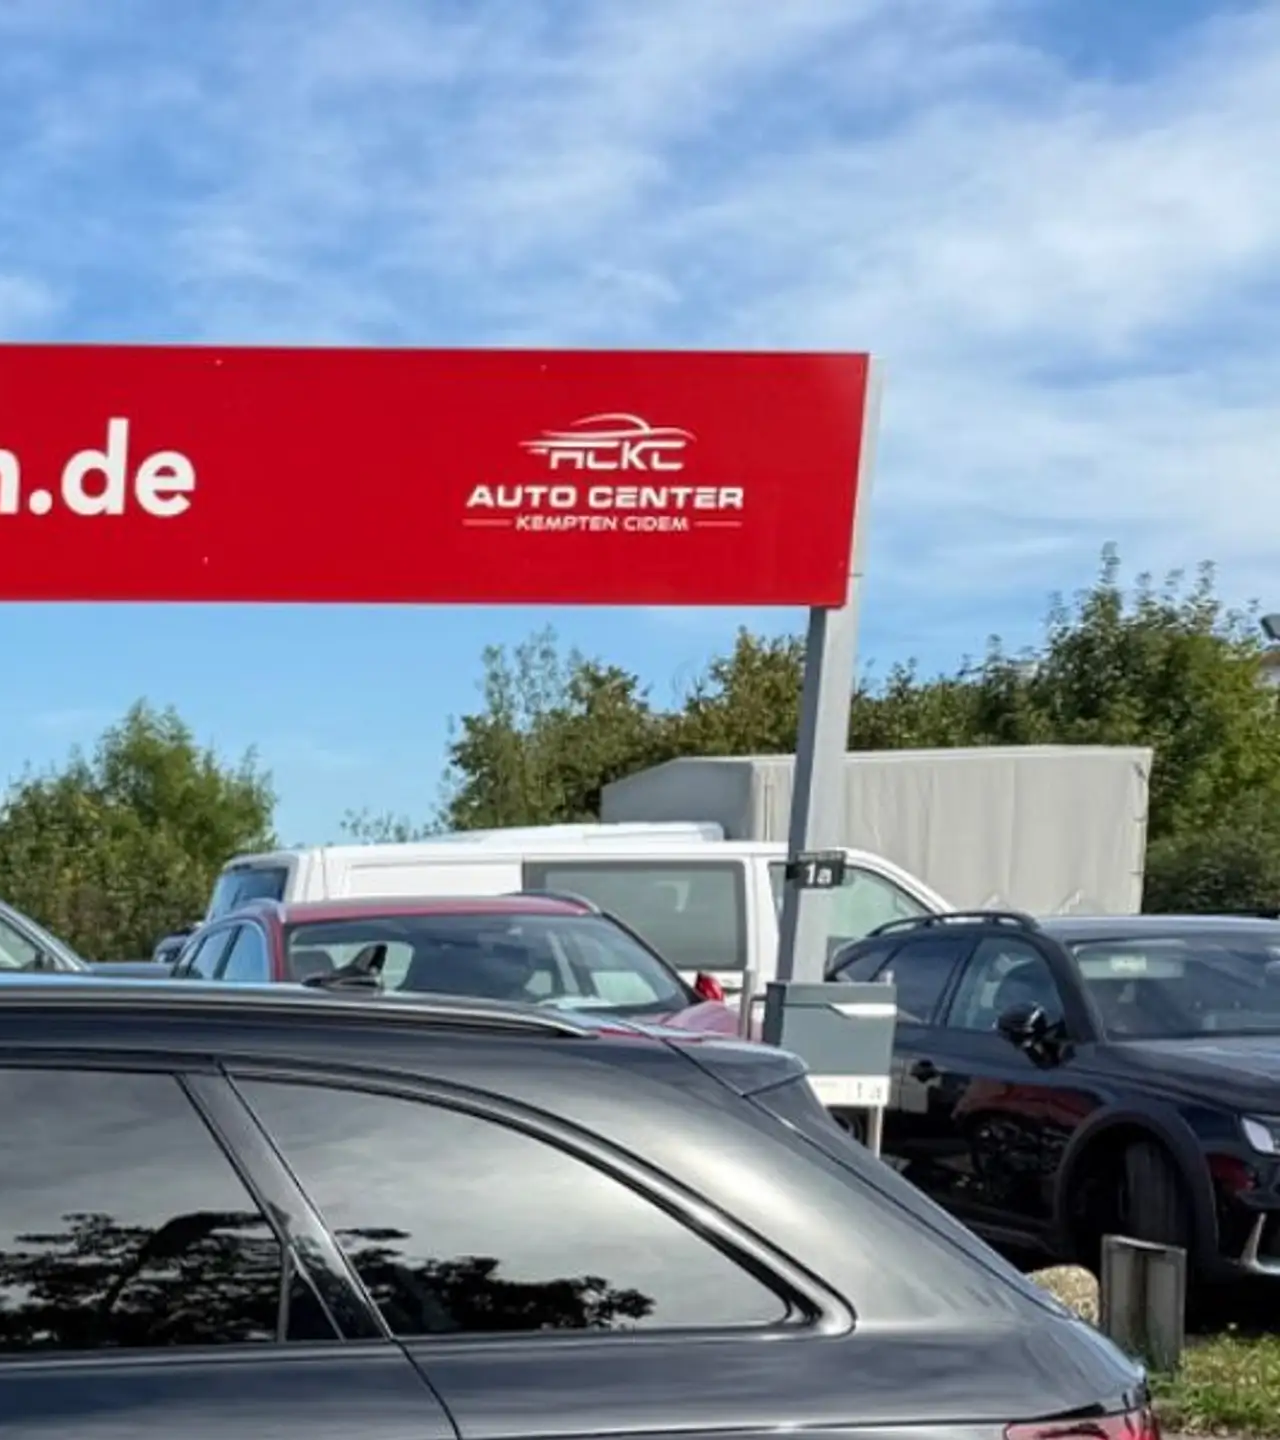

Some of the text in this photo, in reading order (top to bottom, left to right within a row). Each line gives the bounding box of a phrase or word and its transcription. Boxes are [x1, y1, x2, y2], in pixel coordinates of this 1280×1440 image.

[465, 484, 745, 510] AUTO CENTER
[516, 515, 689, 532] KEMPTEN CIDEM
